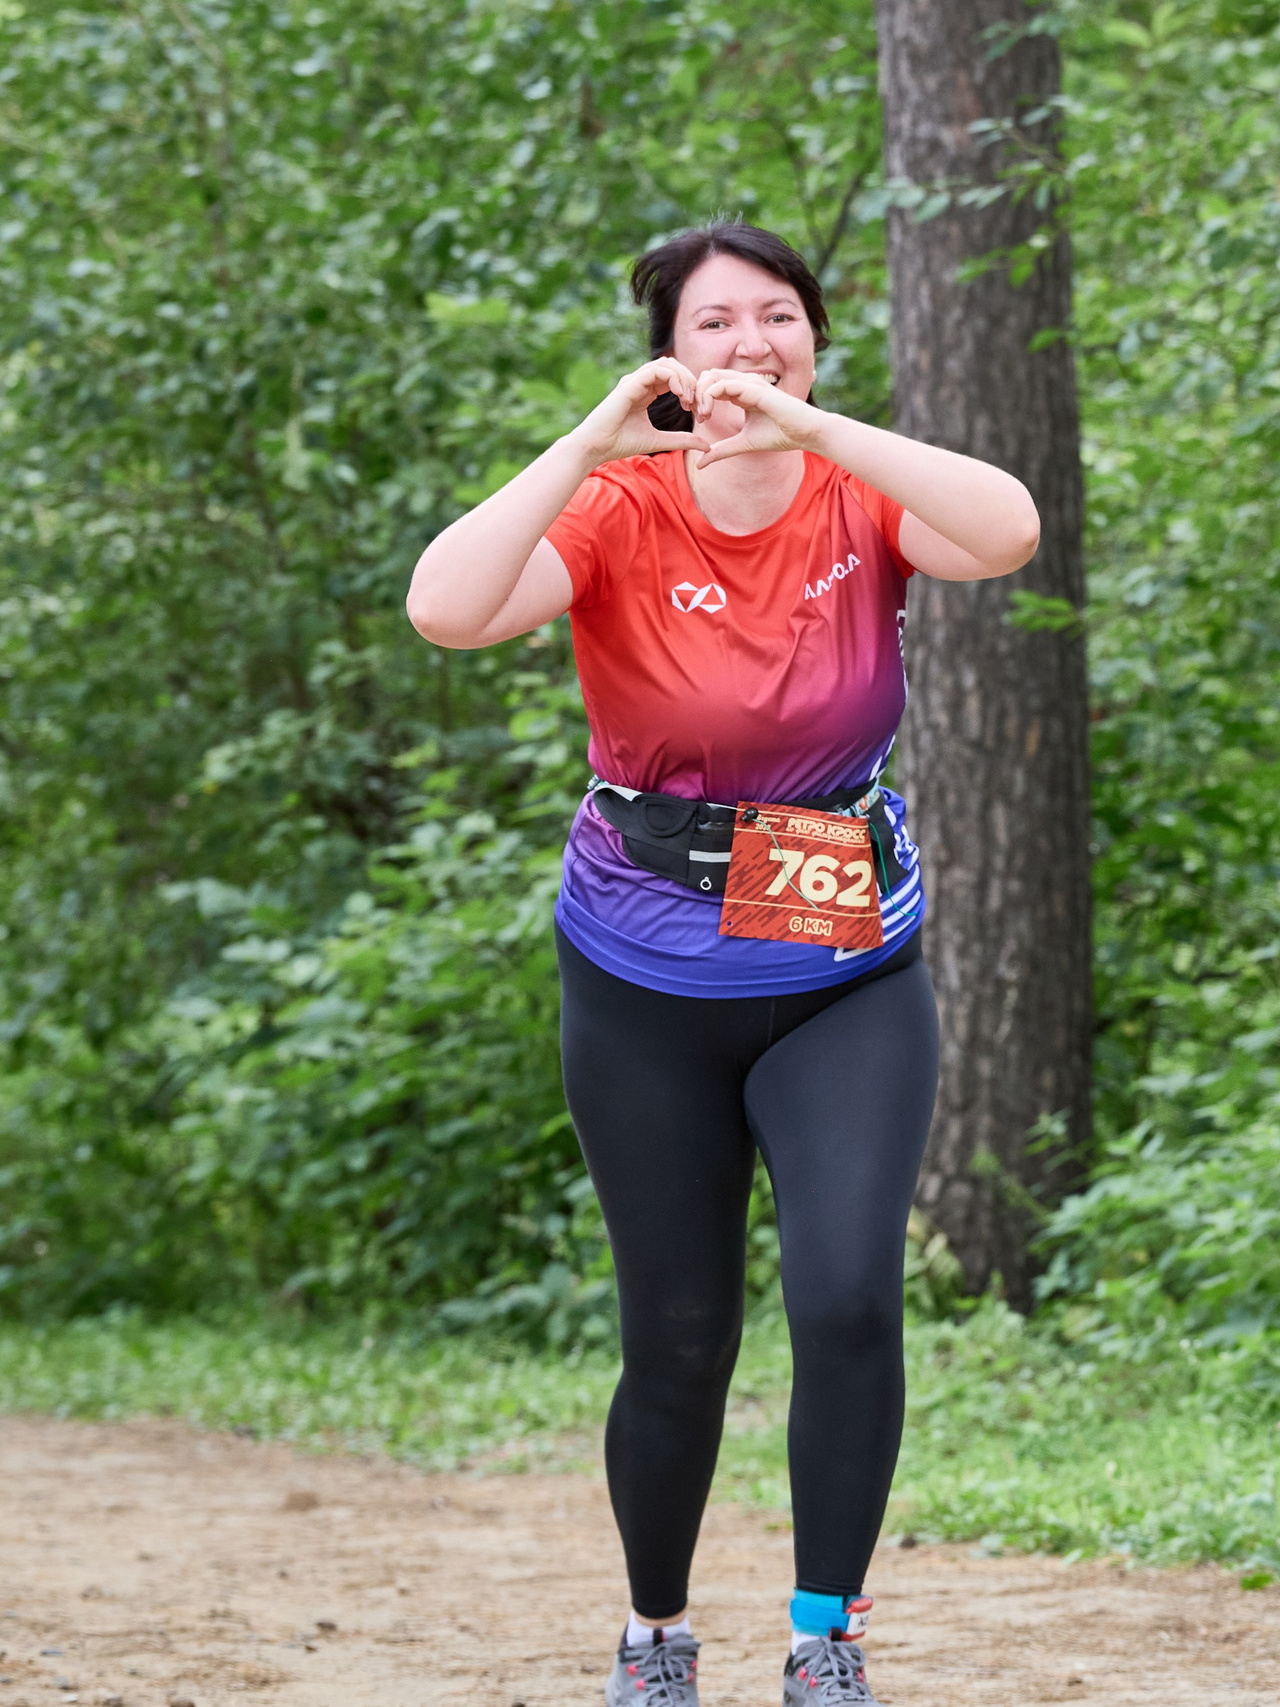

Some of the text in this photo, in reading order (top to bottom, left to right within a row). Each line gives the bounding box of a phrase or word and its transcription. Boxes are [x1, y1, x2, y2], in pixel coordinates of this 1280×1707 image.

[787, 818, 826, 833] РЕТРО
[827, 824, 866, 840] КРОСС
[764, 848, 872, 908] 762
[789, 916, 803, 932] 6
